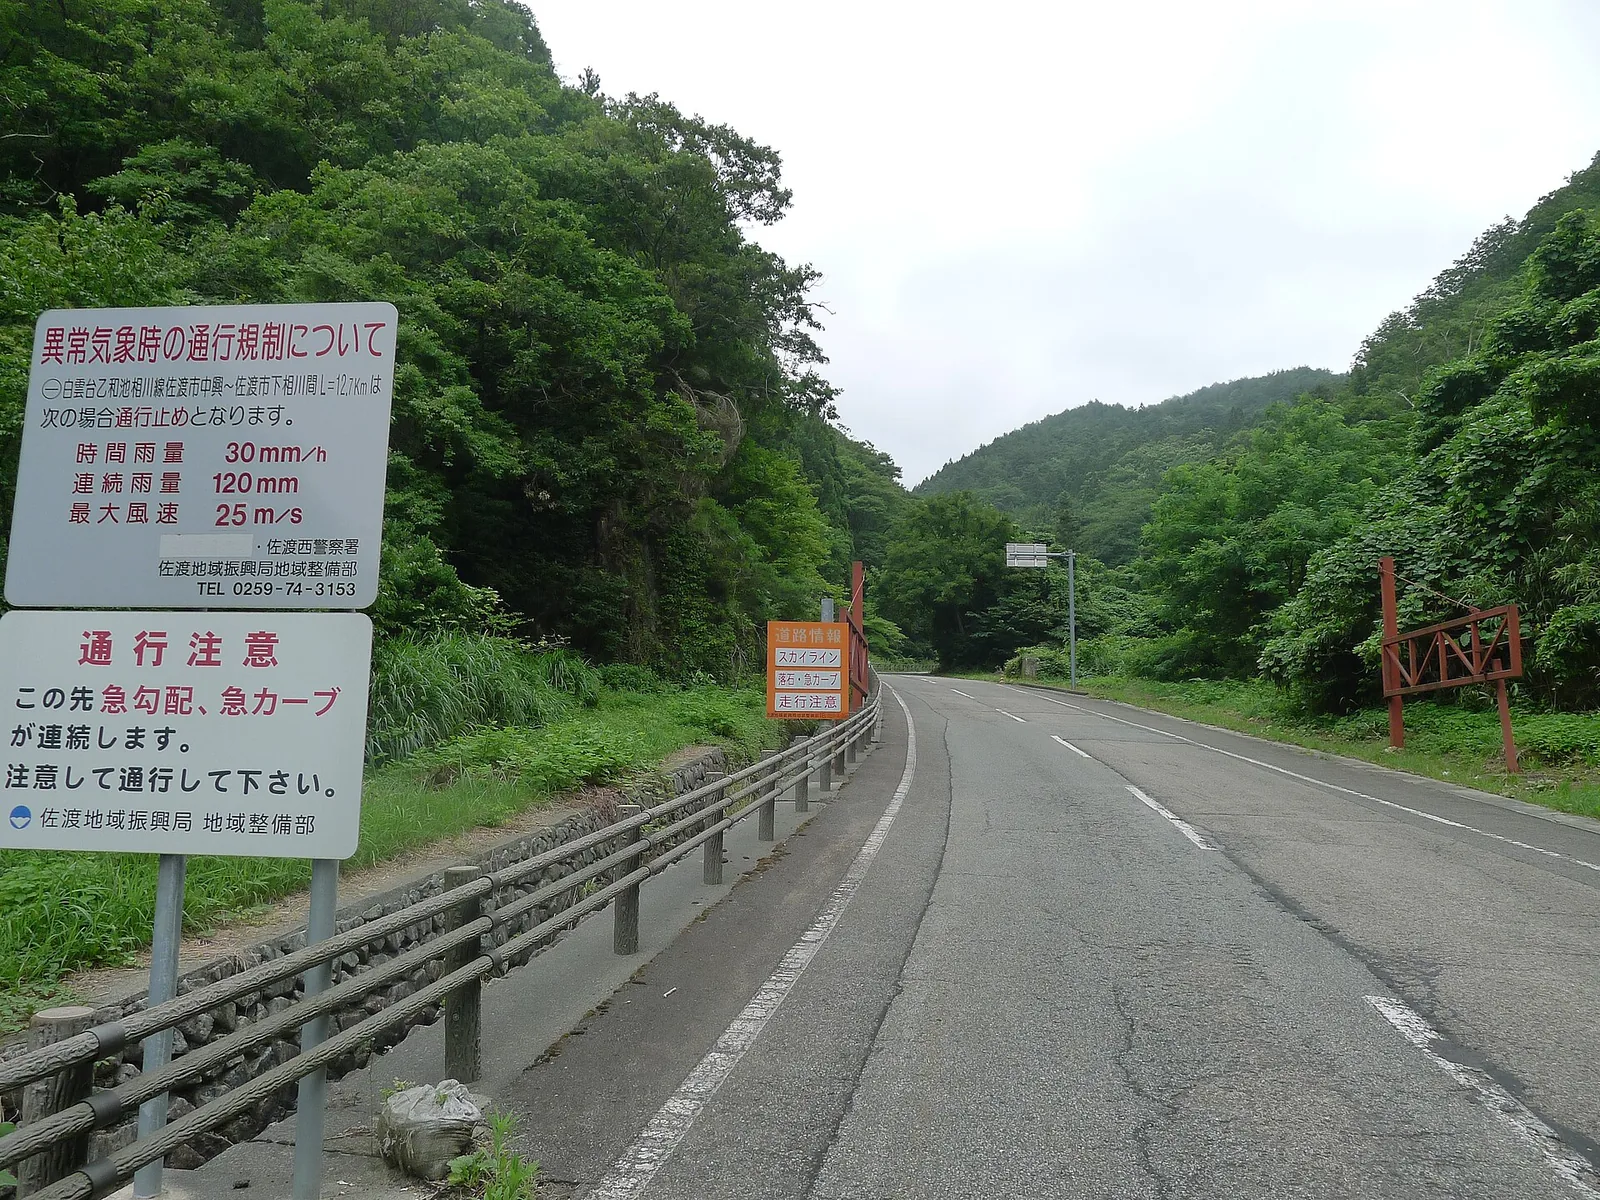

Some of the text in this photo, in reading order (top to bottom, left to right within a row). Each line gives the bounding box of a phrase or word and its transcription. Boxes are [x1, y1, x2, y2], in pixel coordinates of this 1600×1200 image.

[40, 321, 386, 365] 異常気象時の通行規制について
[40, 404, 293, 428] 次の場合通行止めとなります。
[158, 560, 357, 577] 佐渡地域振興局地域整備部
[197, 582, 356, 596] TEL 0259-74-3153
[775, 627, 841, 643] 道路情報
[78, 630, 279, 667] 通行注意
[778, 651, 838, 664] スカイライン
[778, 673, 838, 686] 落石・急カーブ
[15, 684, 342, 717] この先急勾配、急カーブ
[779, 695, 837, 709] 走行注意
[10, 722, 190, 753] が連続します。
[4, 763, 335, 798] 注意して通行して下さい。
[40, 807, 316, 835] 佐渡地域振興局 地域整備部
